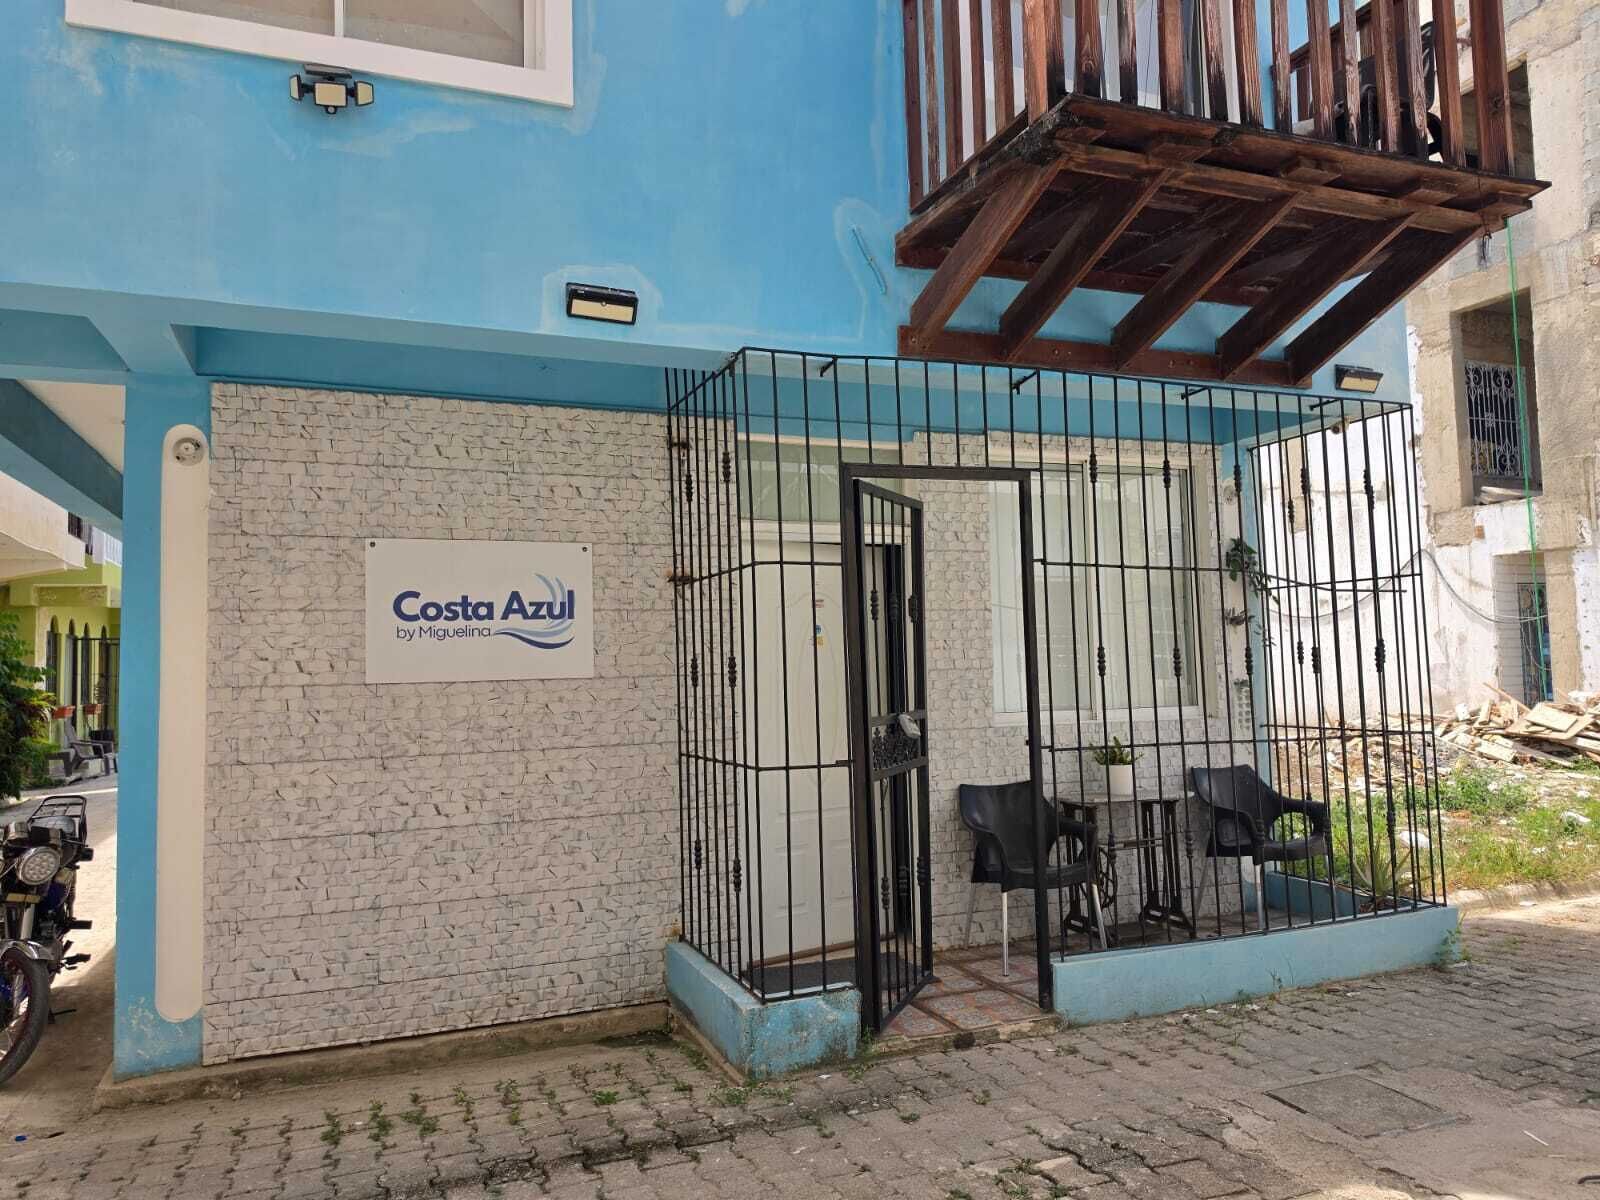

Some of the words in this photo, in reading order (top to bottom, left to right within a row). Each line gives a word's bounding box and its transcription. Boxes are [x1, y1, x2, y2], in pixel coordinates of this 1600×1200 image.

[393, 590, 494, 622] Costa
[500, 590, 575, 620] Azul
[396, 625, 416, 642] by
[419, 625, 491, 642] Miguelina
